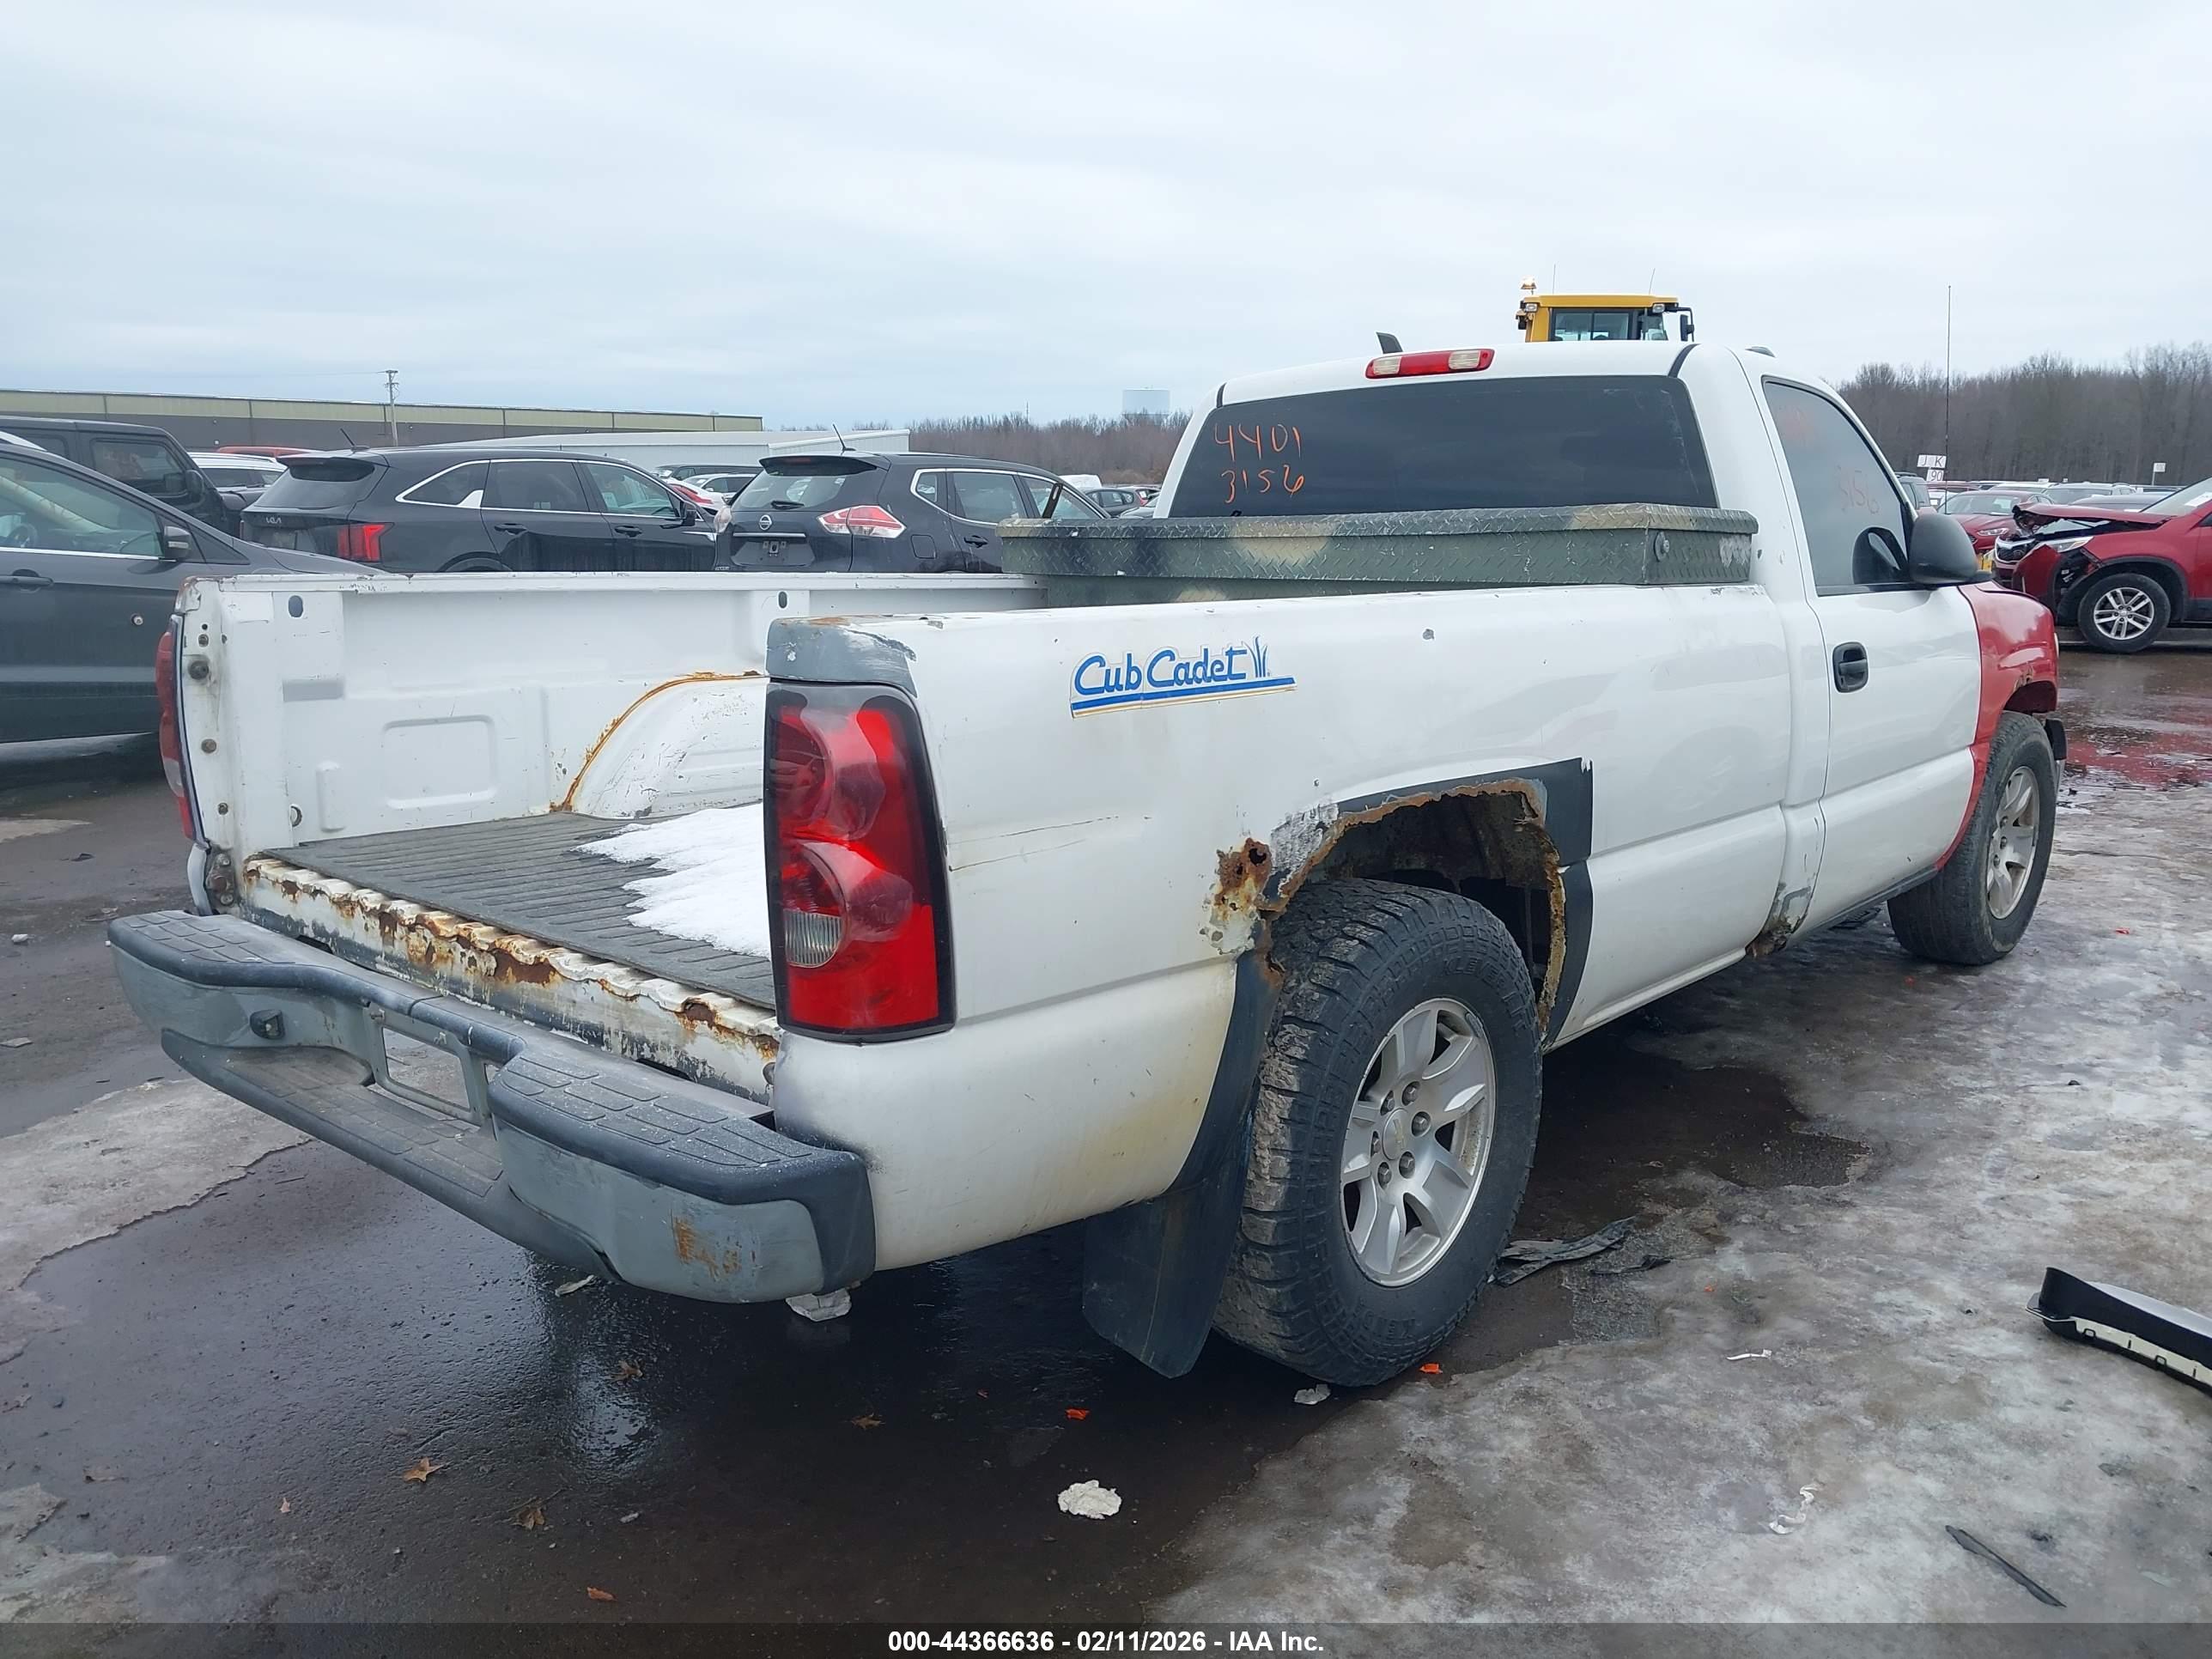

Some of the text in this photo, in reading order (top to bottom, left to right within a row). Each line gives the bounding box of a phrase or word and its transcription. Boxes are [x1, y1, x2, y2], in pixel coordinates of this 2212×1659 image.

[1214, 423, 1302, 461] 4401
[1934, 455, 1944, 467] K
[1221, 465, 1305, 503] 3156
[1931, 470, 1943, 481] 90
[1074, 646, 1248, 696] Cub Cadet
